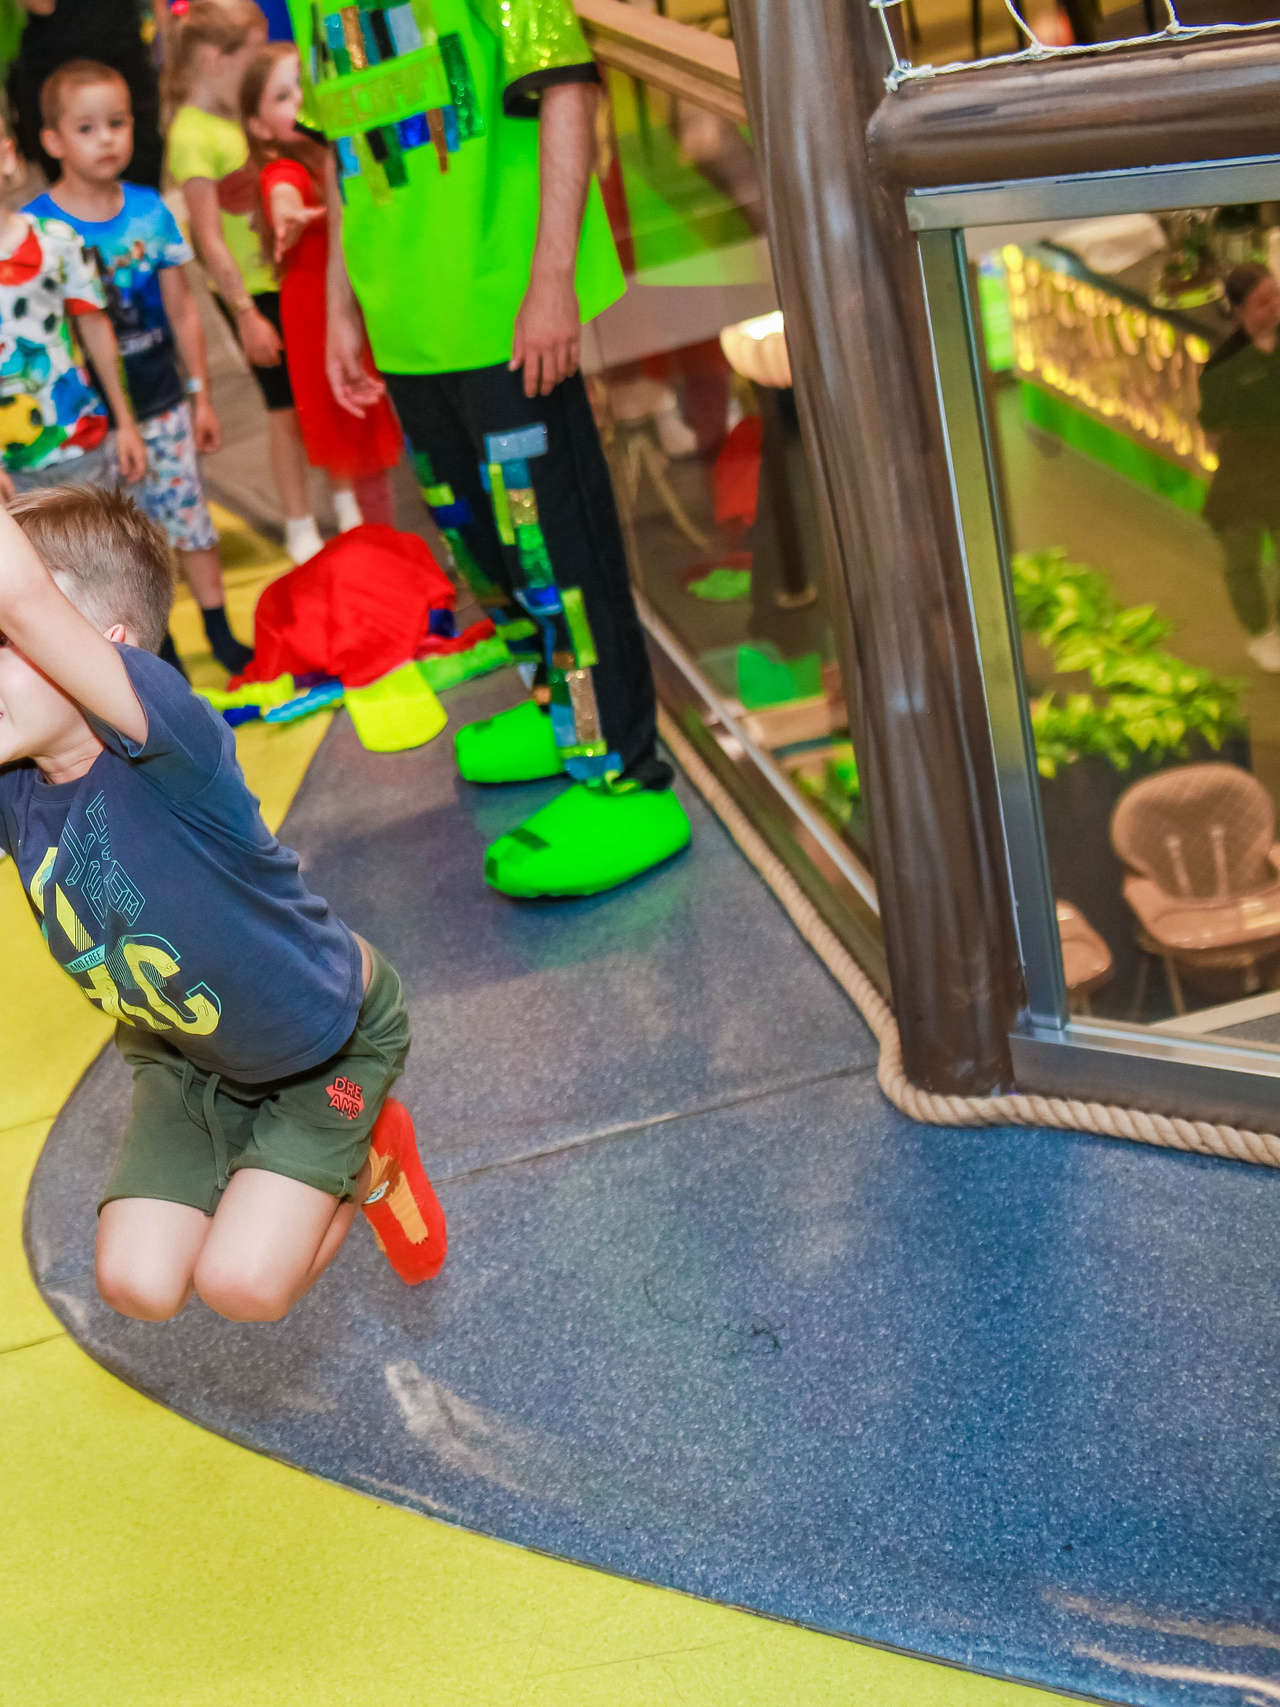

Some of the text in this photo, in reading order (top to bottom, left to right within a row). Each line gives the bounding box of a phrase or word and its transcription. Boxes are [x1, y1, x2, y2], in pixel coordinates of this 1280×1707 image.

[70, 949, 103, 972] AND FREE
[333, 1076, 363, 1101] DRE
[328, 1094, 359, 1119] AMS
